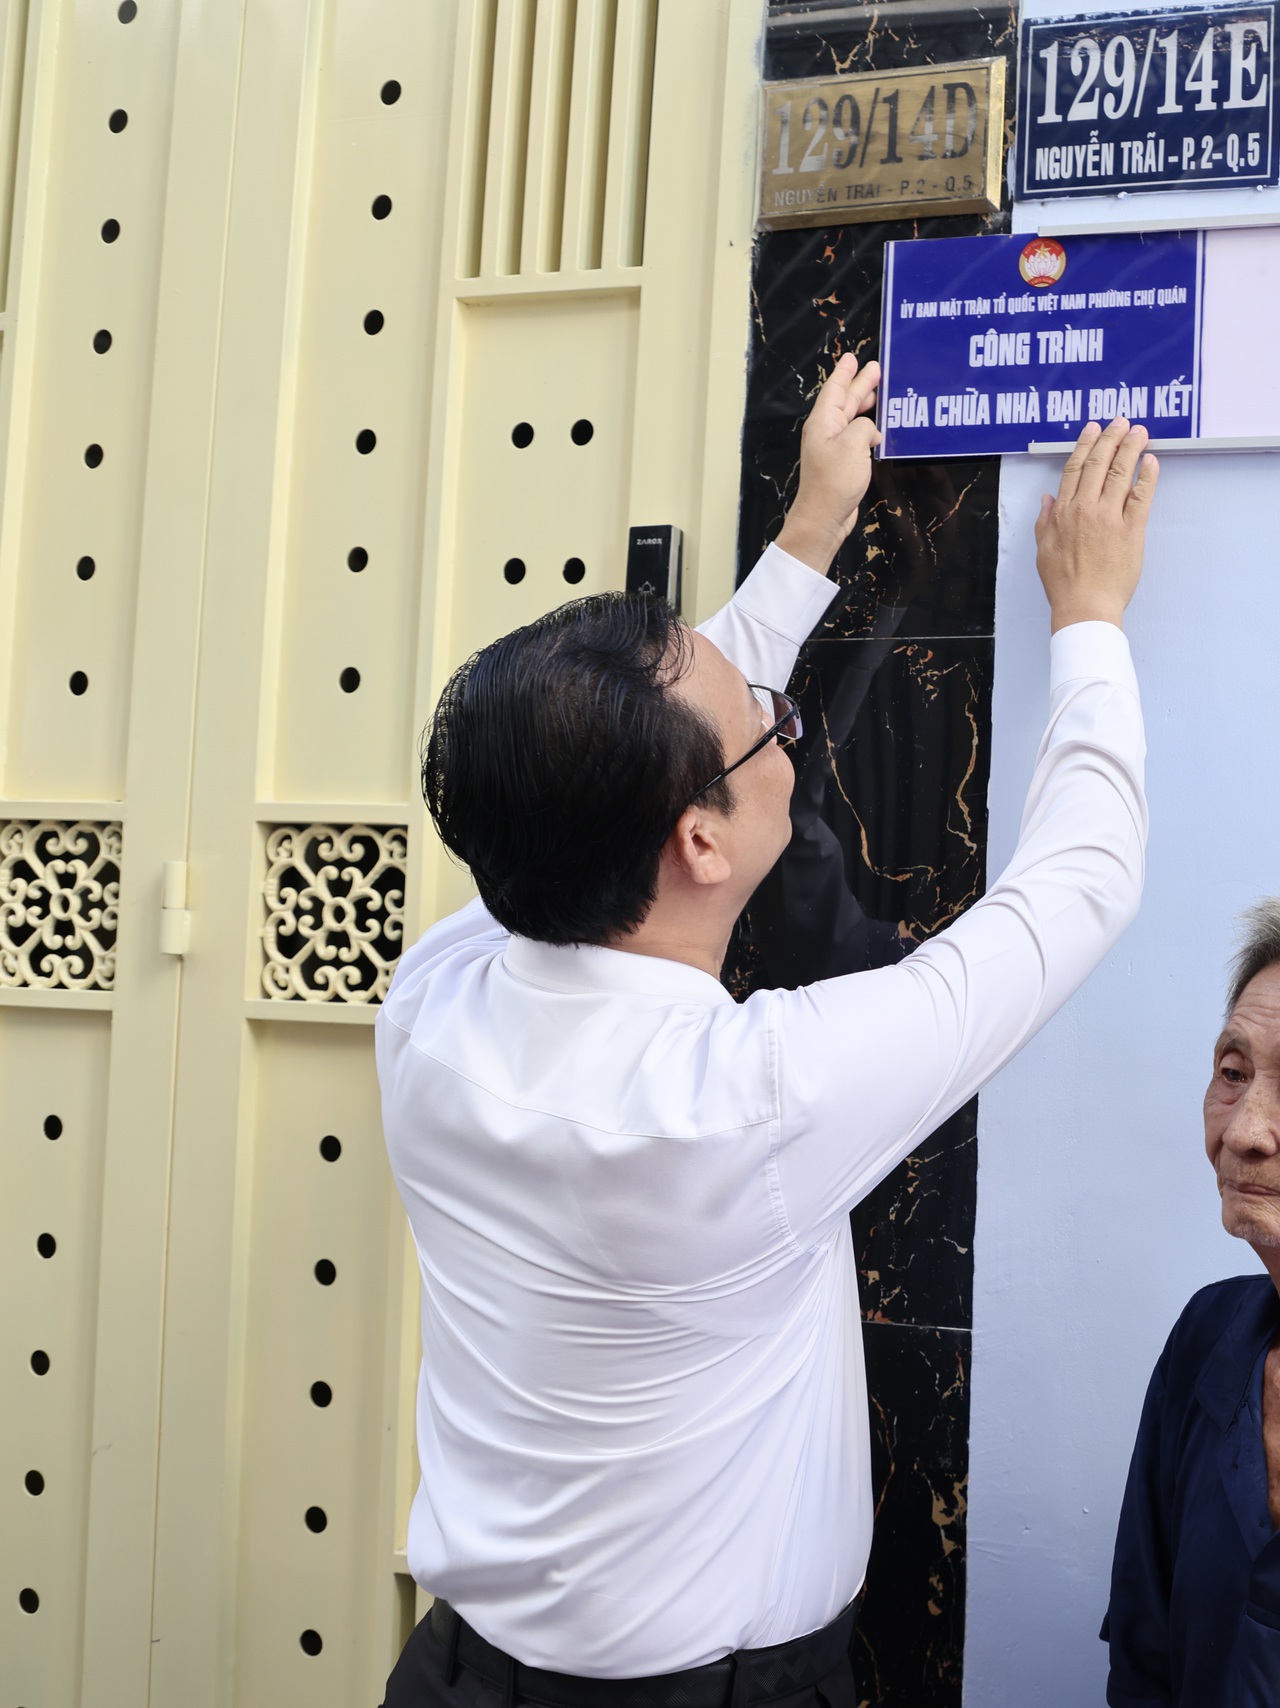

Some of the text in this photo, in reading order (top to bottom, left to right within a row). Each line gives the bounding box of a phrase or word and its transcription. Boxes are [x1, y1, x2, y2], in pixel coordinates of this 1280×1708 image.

[1037, 20, 1268, 124] 129/14E
[772, 82, 978, 175] 129/14D
[1035, 130, 1114, 181] NGUYỄN
[1120, 131, 1165, 174] TRÃI
[916, 301, 938, 318] BAN
[939, 297, 963, 320] MẶT
[964, 296, 991, 319] TRẬN
[1007, 291, 1036, 315] QUỐC
[1037, 292, 1059, 315] VIỆT
[1060, 293, 1087, 311] NAM
[1133, 287, 1156, 309] CHỢ
[1157, 284, 1188, 307] QUÁN
[968, 323, 1104, 368] CÔNG TRÌNH
[887, 375, 1193, 430] SỬA CHỮA NHÀ ĐẠI ĐOÀN KẾT
